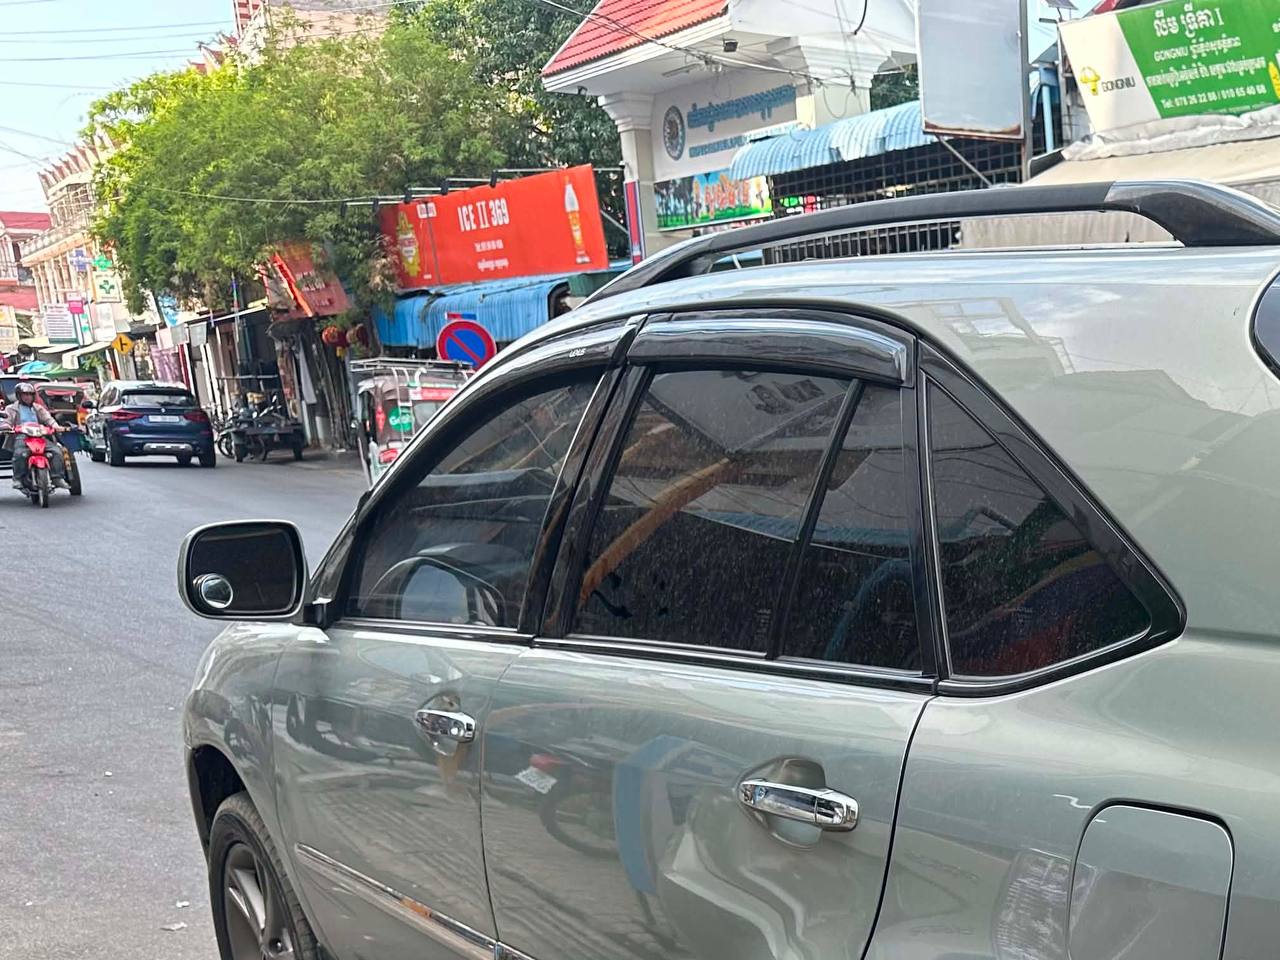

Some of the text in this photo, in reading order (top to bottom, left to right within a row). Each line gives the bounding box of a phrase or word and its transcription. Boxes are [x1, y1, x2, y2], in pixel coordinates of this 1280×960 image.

[457, 204, 477, 232] ICE
[476, 200, 490, 229] II
[489, 198, 510, 226] 369
